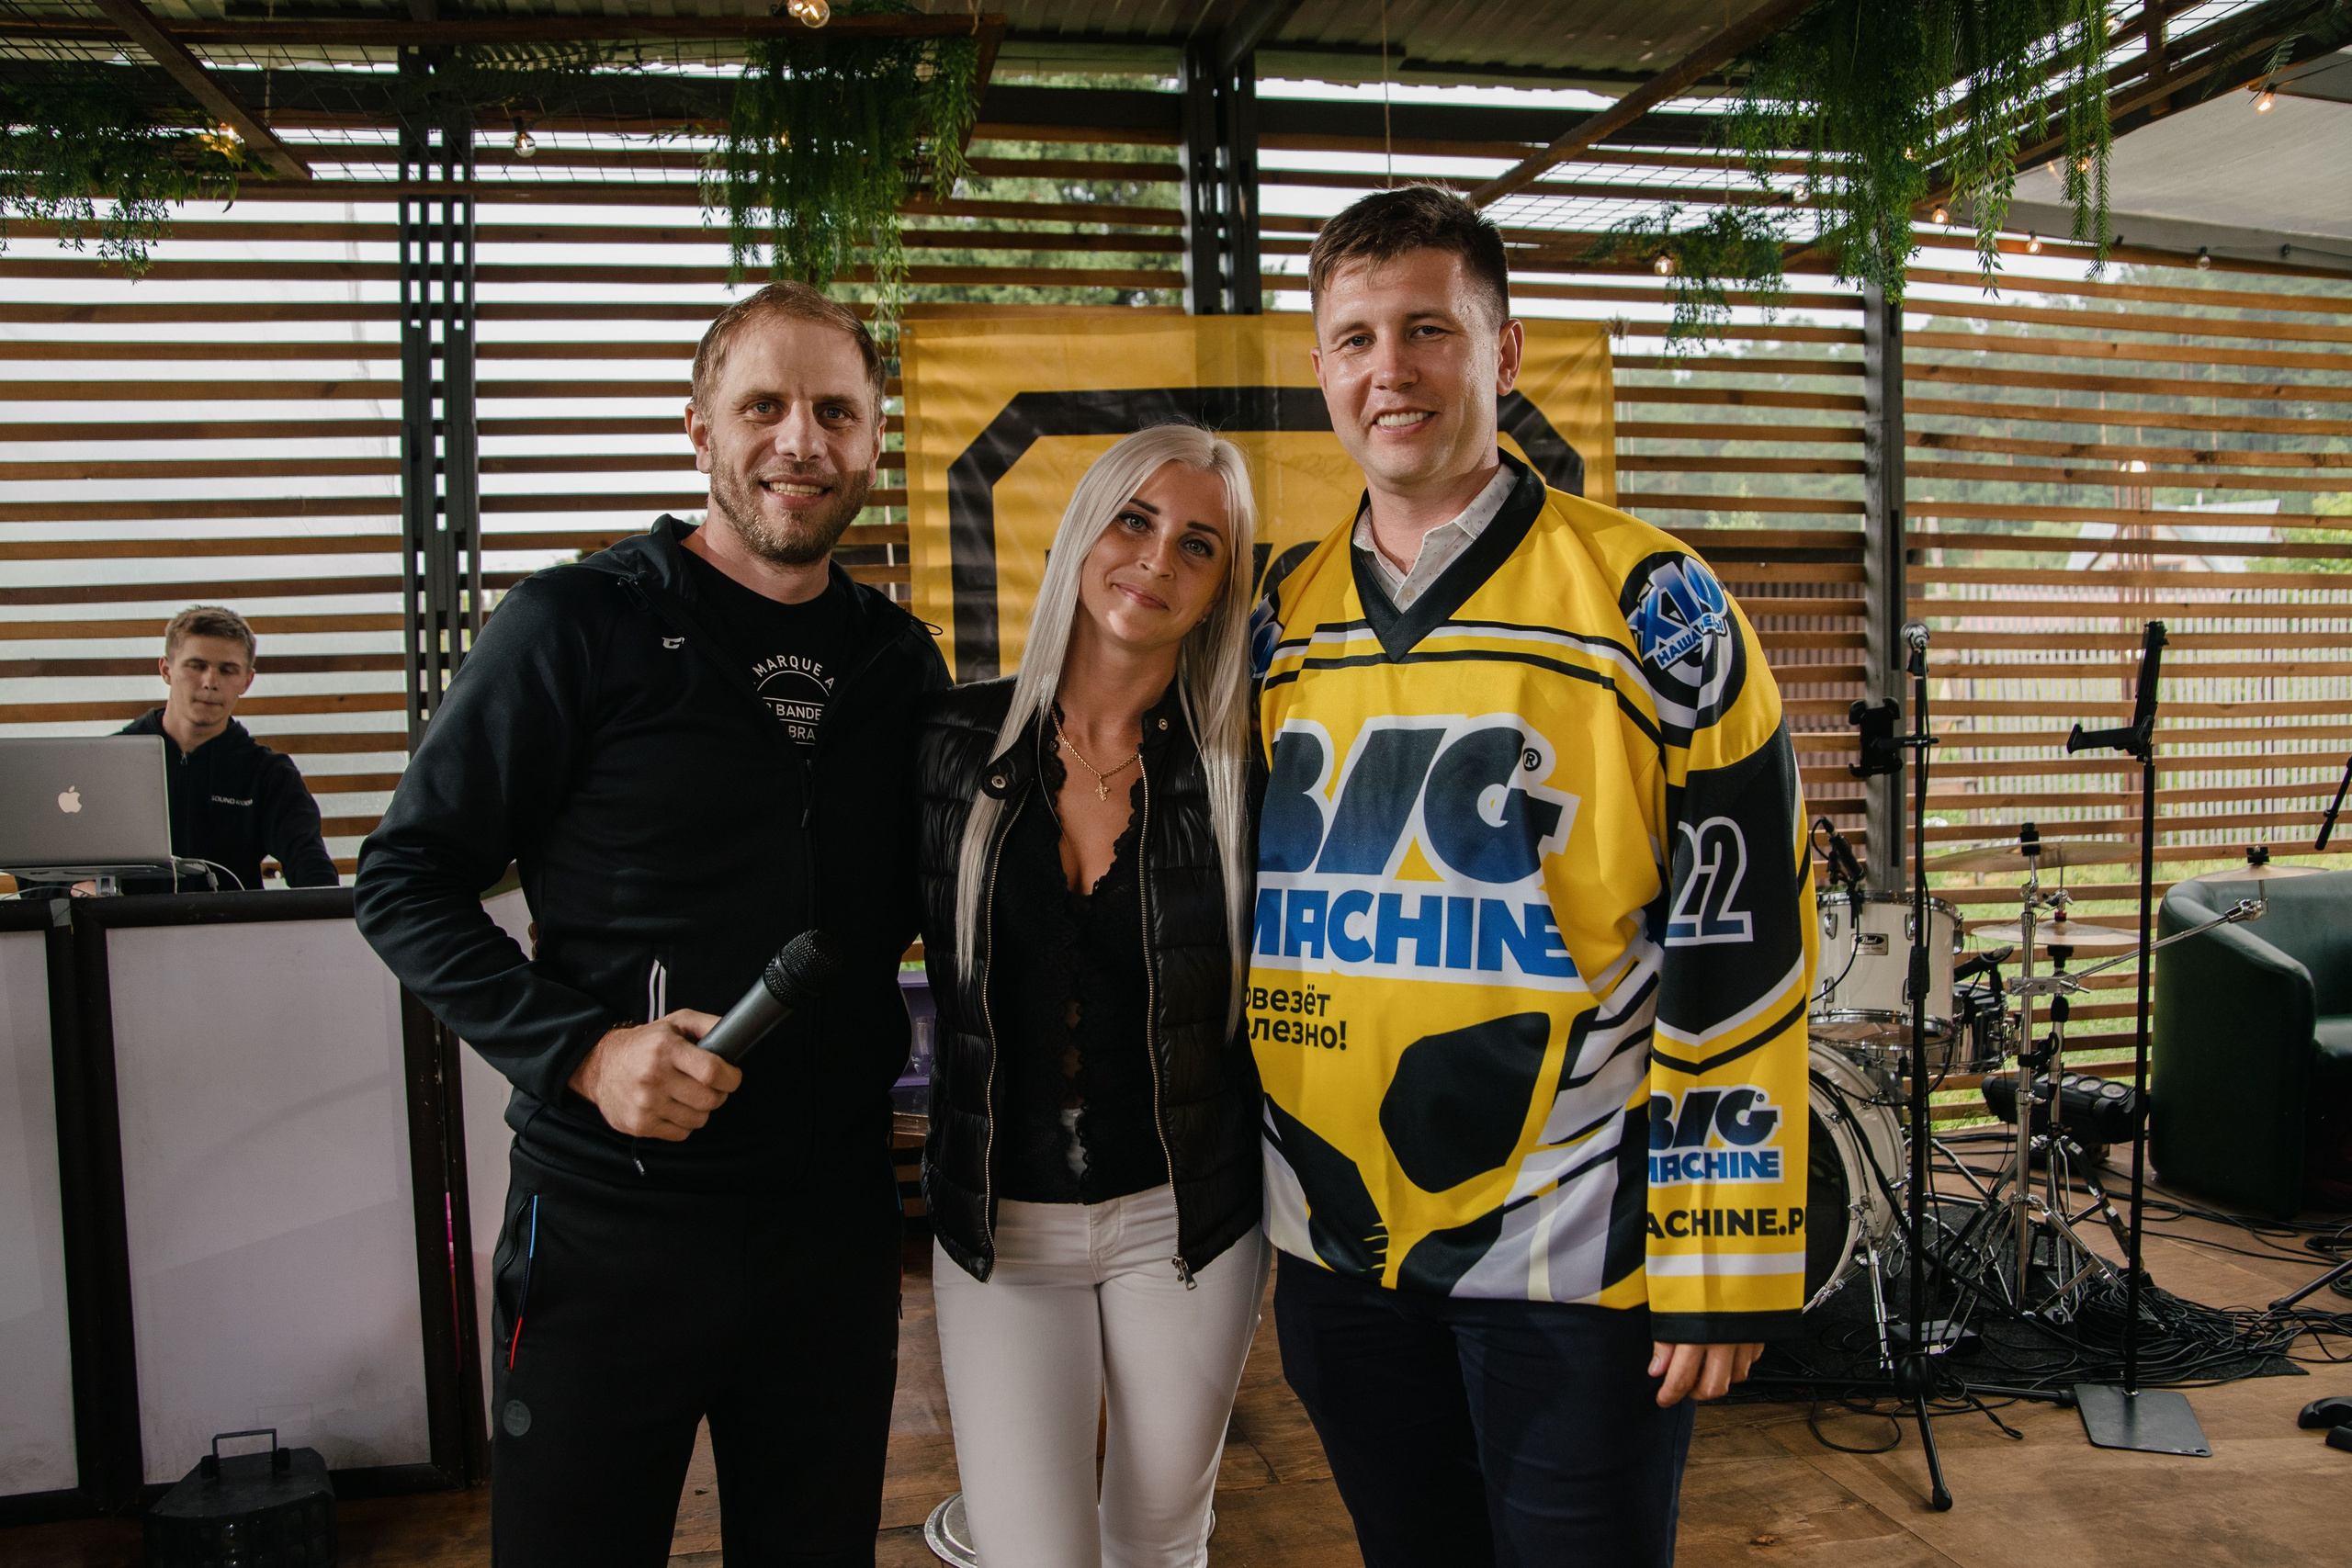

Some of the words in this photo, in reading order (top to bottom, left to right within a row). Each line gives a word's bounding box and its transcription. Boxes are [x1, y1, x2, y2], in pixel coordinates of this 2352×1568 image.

[1656, 629, 1702, 667] НАША
[752, 655, 823, 678] MARQUE
[824, 676, 835, 690] A
[1664, 816, 1754, 947] 22
[1246, 1016, 1347, 1051] лезно!
[1649, 1151, 1780, 1183] ACHINE
[1646, 1206, 1807, 1239] ACHINE.P
